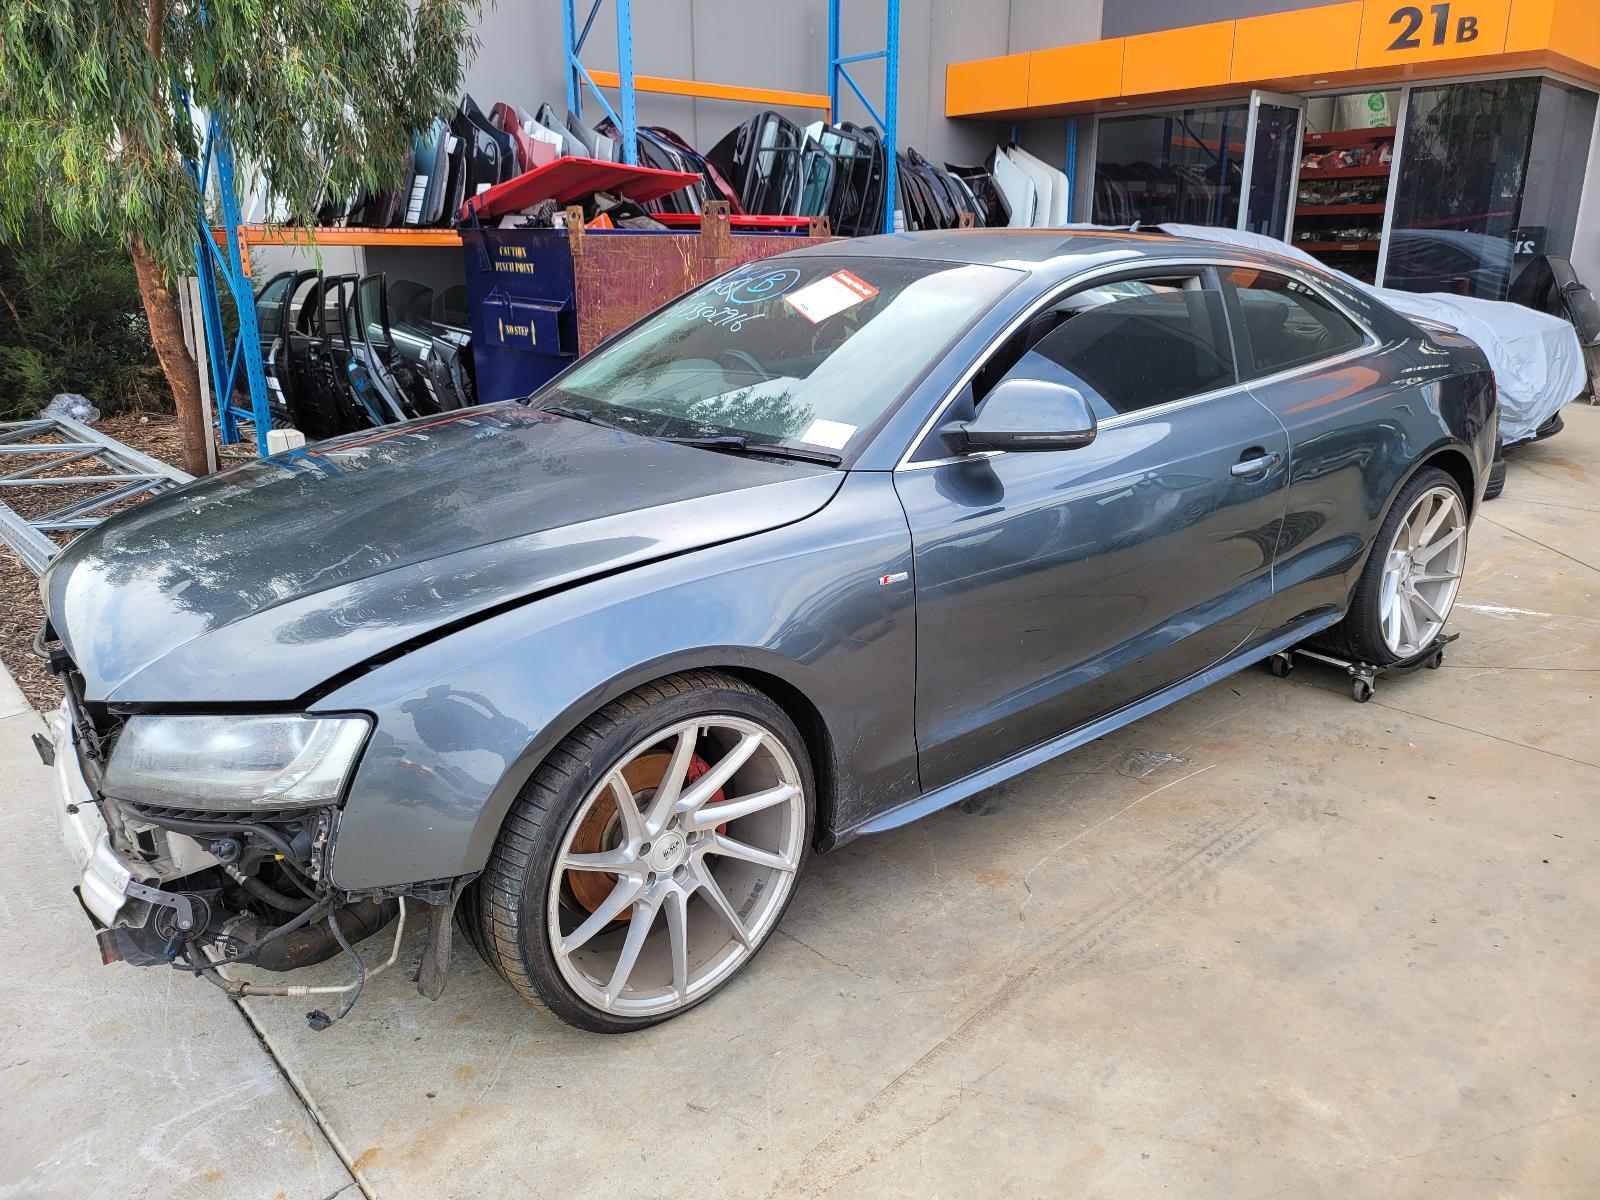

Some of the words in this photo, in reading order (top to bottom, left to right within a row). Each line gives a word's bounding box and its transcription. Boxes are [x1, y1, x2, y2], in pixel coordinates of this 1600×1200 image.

[499, 246, 527, 258] CAUTION
[495, 262, 515, 273] PINCH
[515, 262, 535, 274] POINT
[505, 324, 514, 335] NO
[513, 325, 529, 336] STEP
